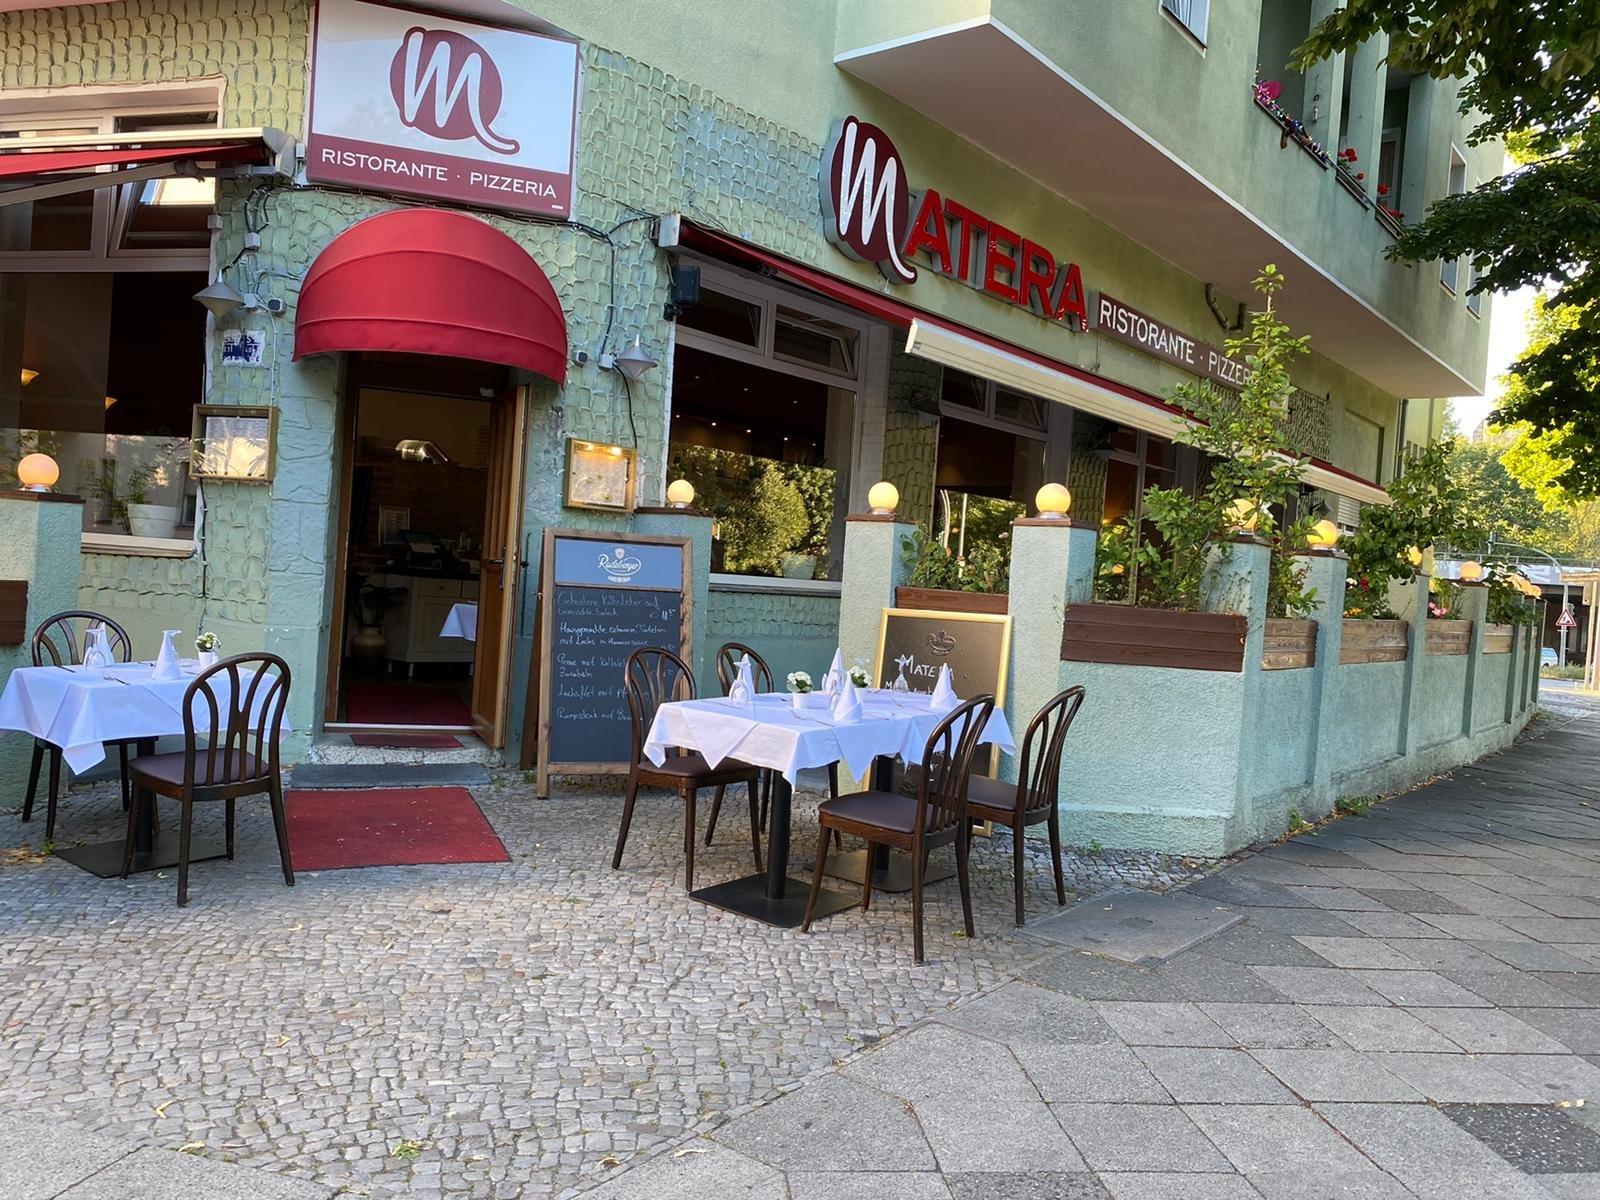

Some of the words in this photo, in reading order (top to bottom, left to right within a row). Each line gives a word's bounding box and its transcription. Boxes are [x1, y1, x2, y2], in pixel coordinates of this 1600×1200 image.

[322, 149, 449, 182] RISTORANTE
[470, 172, 557, 198] PIZZERIA
[839, 121, 1089, 333] MATERA
[1100, 299, 1195, 365] RISTORANTE
[1208, 351, 1251, 386] PIZZER
[898, 654, 955, 681] MATE
